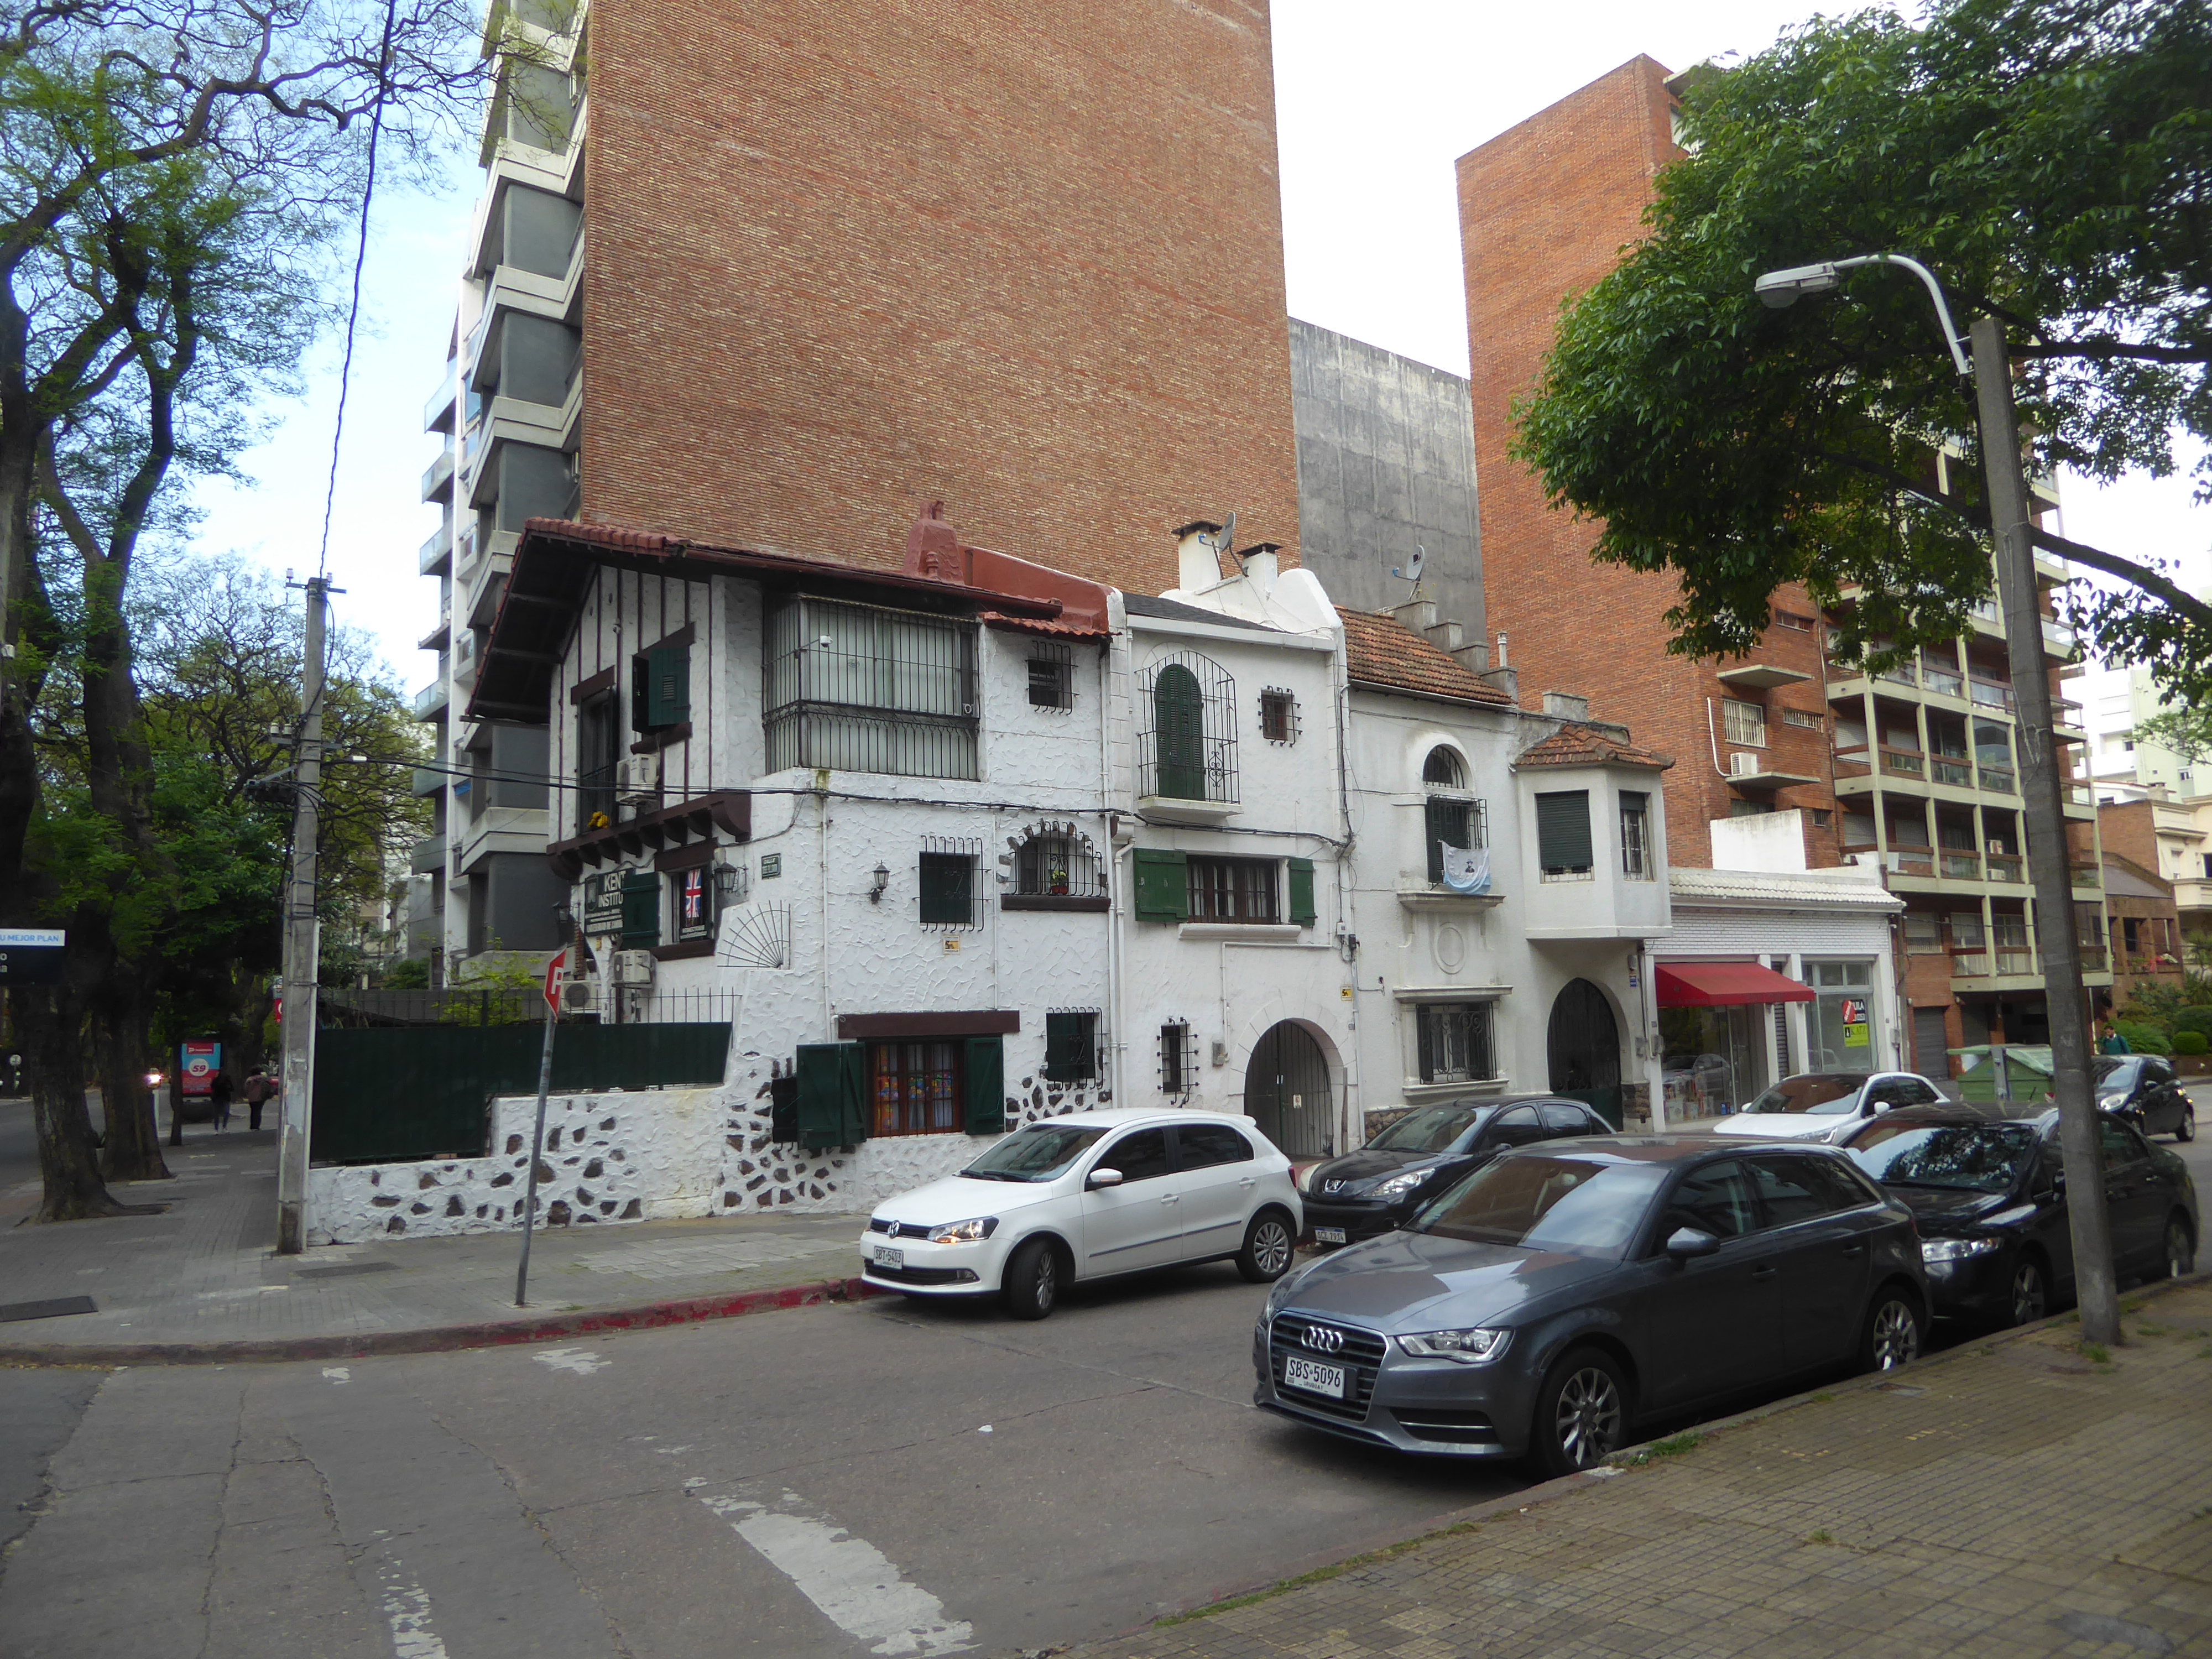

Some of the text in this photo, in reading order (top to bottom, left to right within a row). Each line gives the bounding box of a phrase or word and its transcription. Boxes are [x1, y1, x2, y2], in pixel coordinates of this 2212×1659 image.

[604, 870, 627, 892] KENT
[1289, 1359, 1340, 1387] SBS 5096
